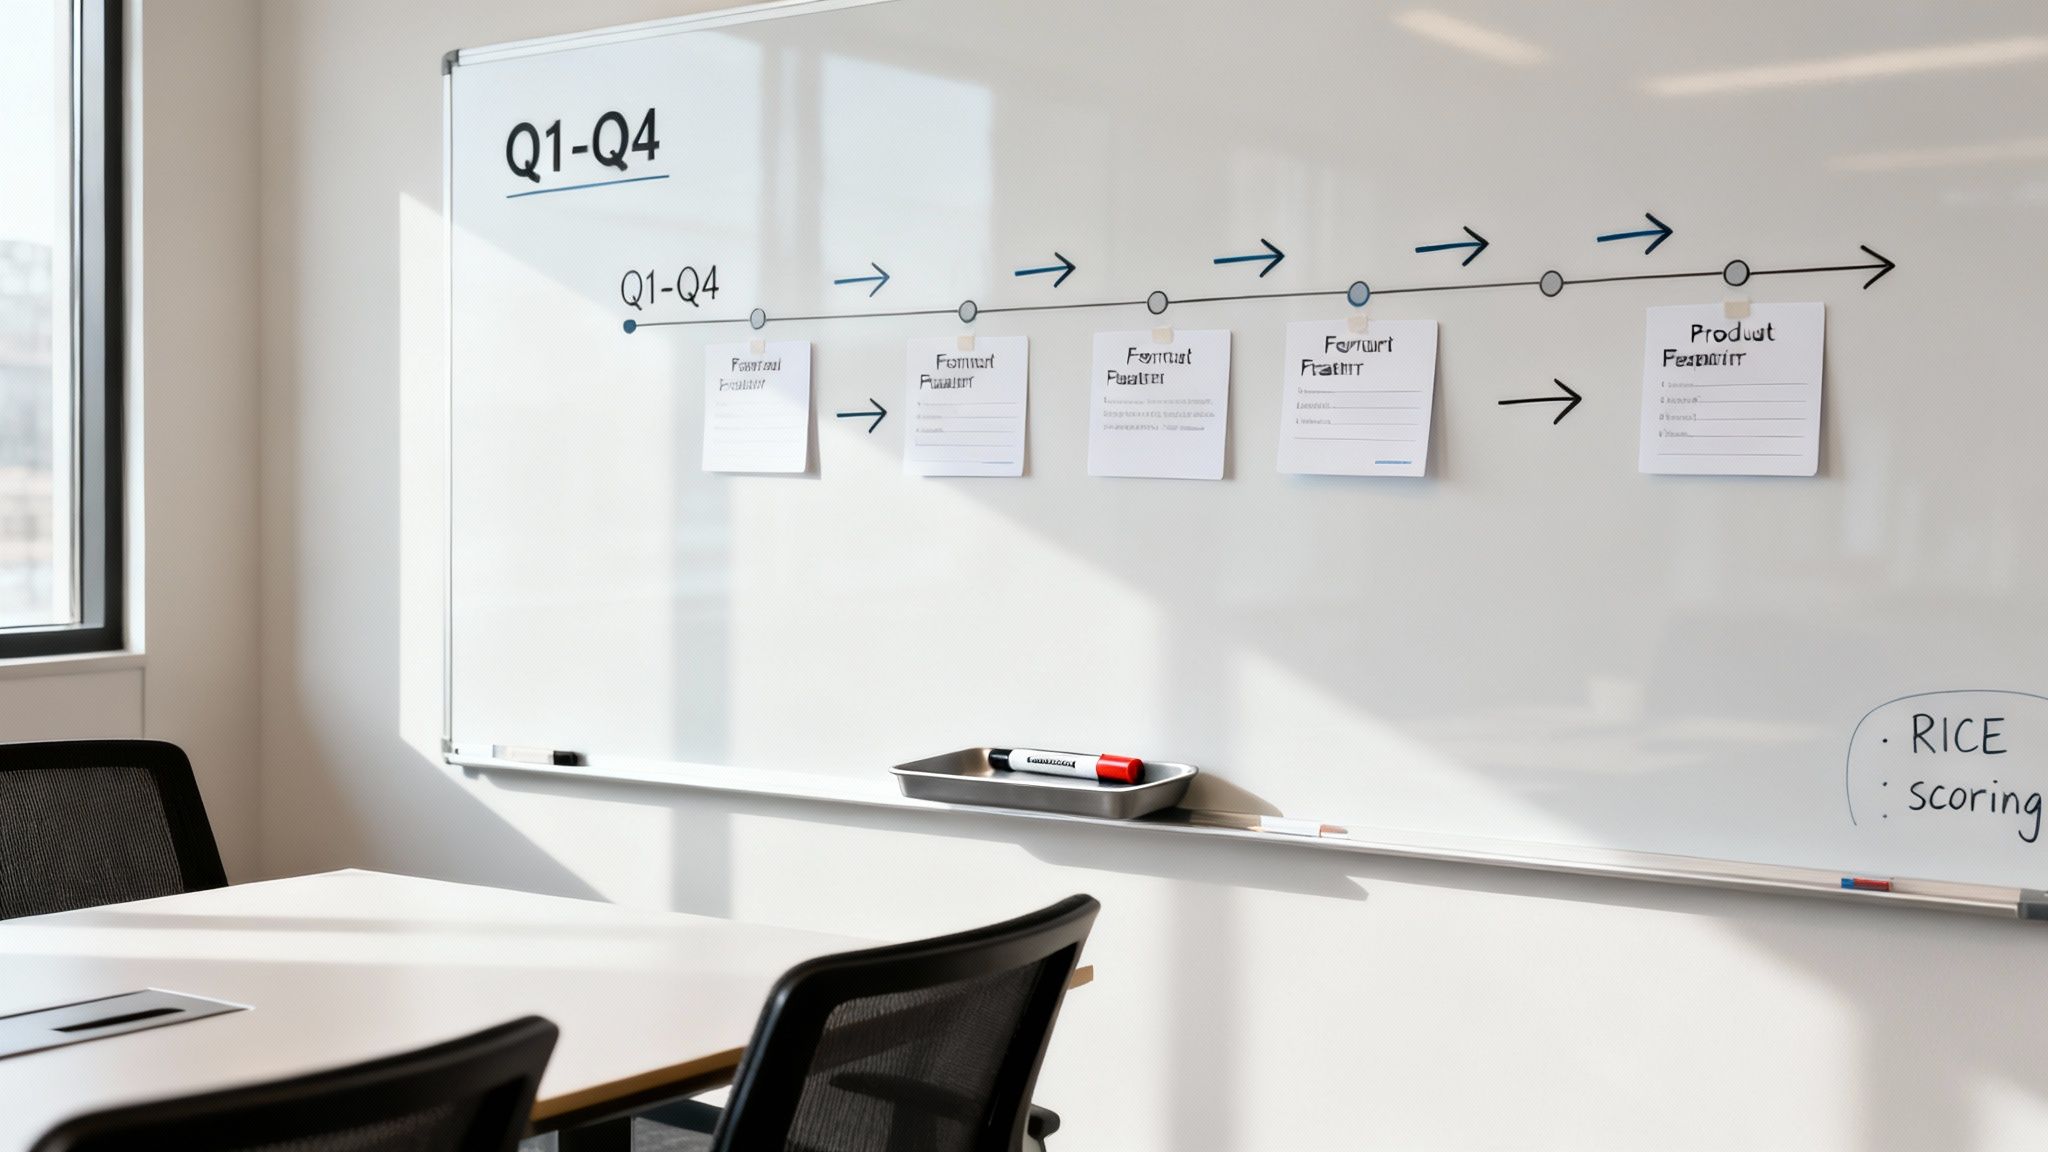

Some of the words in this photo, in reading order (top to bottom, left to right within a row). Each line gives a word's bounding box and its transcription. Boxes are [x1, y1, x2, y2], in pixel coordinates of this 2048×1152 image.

[505, 107, 660, 183] Q1-Q4
[620, 264, 720, 311] Q1-Q4
[1912, 713, 2007, 754] RICE
